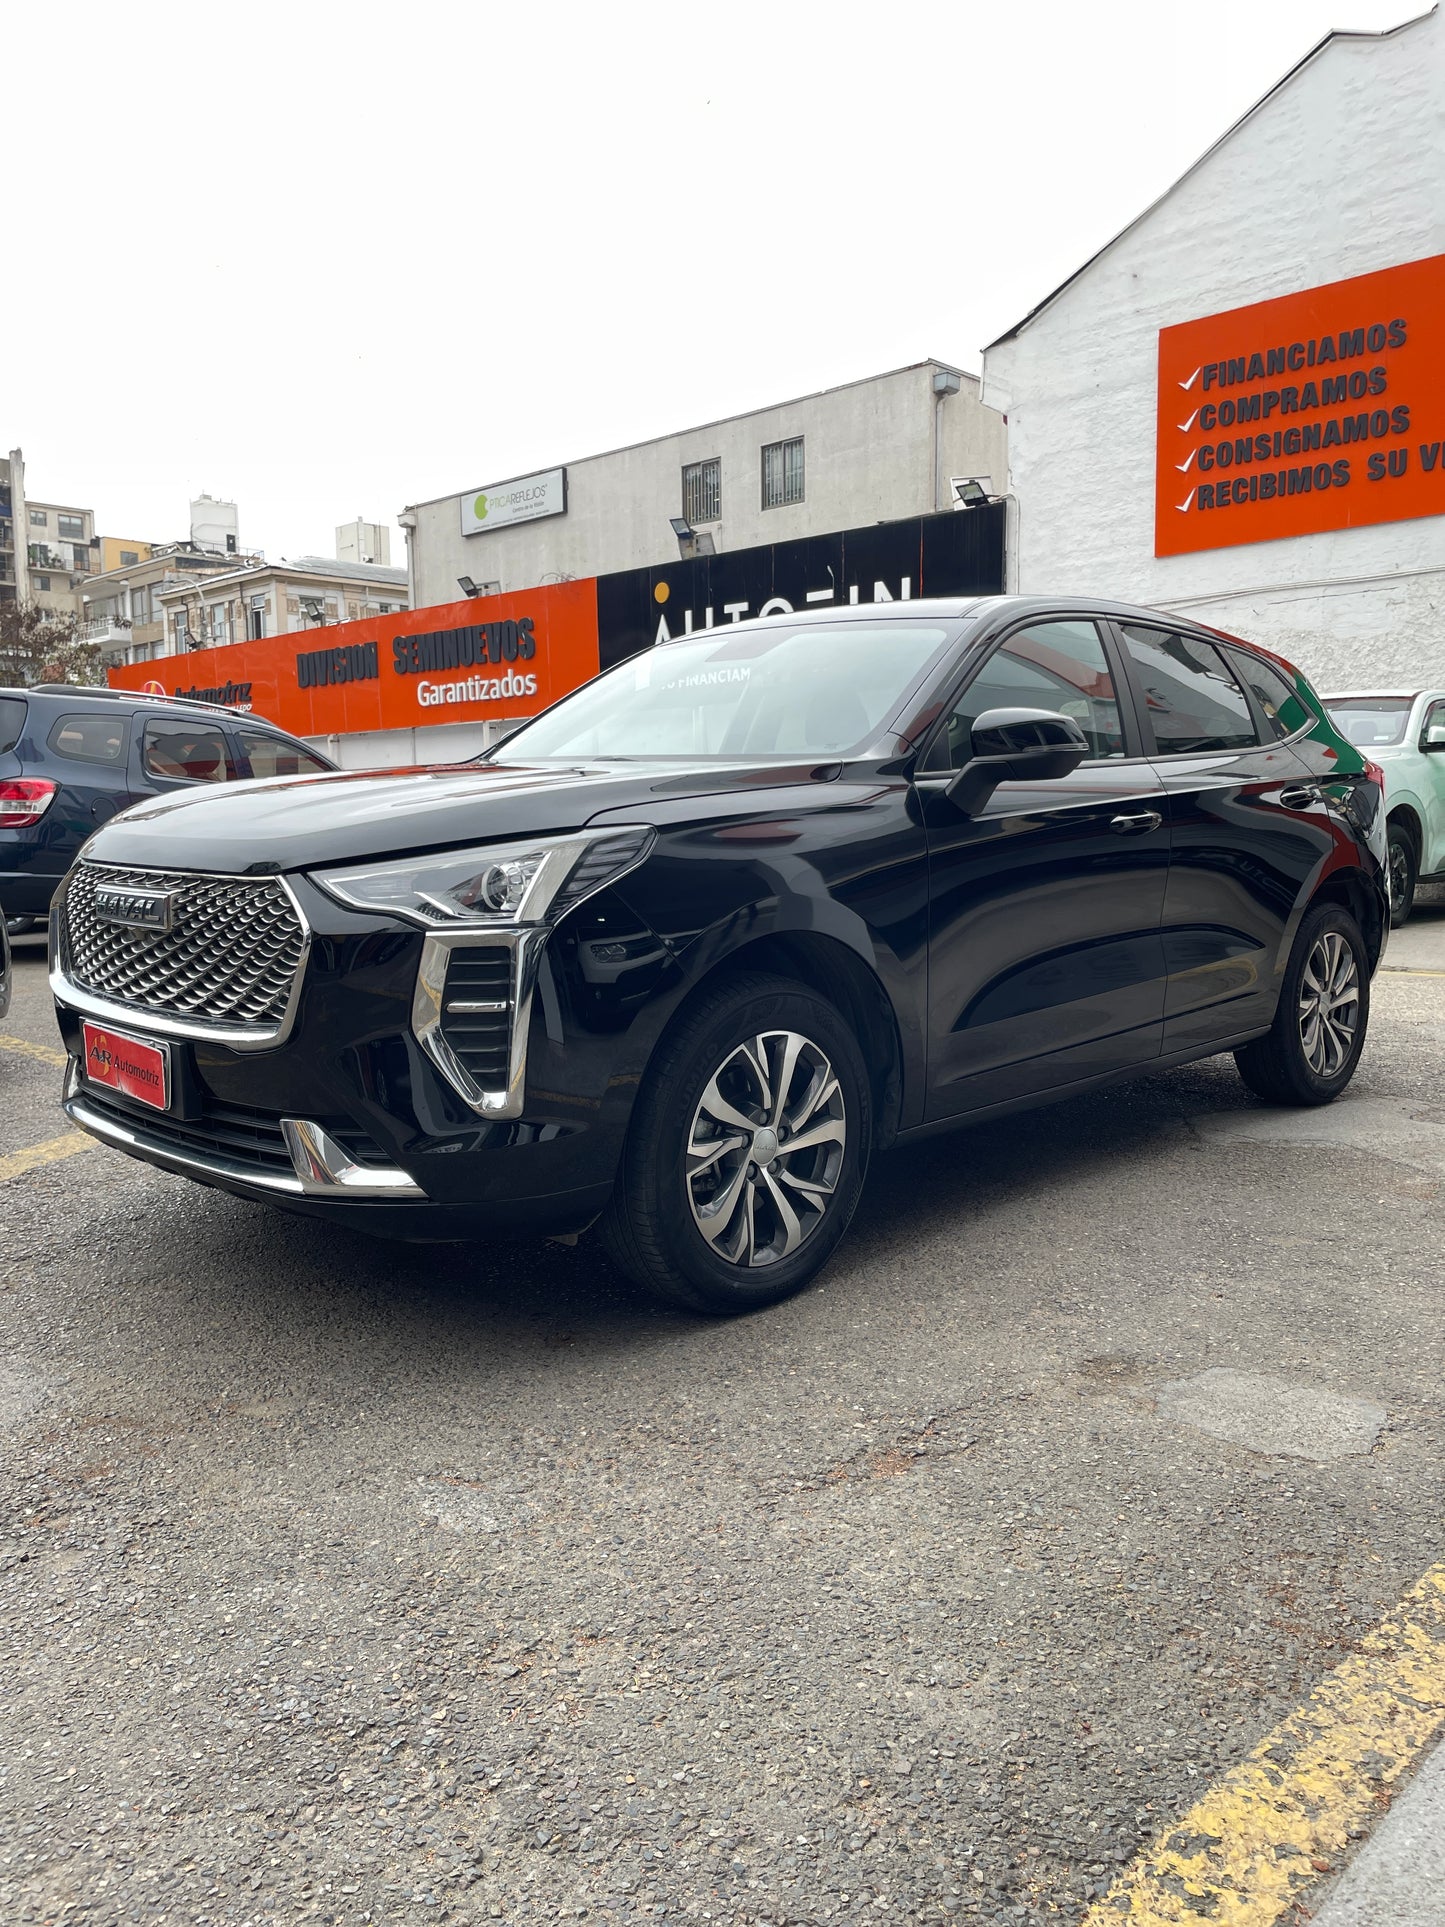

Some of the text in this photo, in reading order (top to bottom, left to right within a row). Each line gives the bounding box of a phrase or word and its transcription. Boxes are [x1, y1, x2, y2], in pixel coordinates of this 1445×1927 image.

[1202, 318, 1407, 391] FINANCIAMOS
[1199, 366, 1387, 431] COMPRAMOS
[1197, 404, 1410, 472] CONSIGNAMOS
[1197, 440, 1445, 511] RECIBIMOS SU V
[296, 617, 536, 688] DIVISION SEMINUEVOS
[417, 669, 538, 707] Garantizados
[96, 893, 160, 921] HAVAL
[114, 1055, 160, 1087] Automotriz
